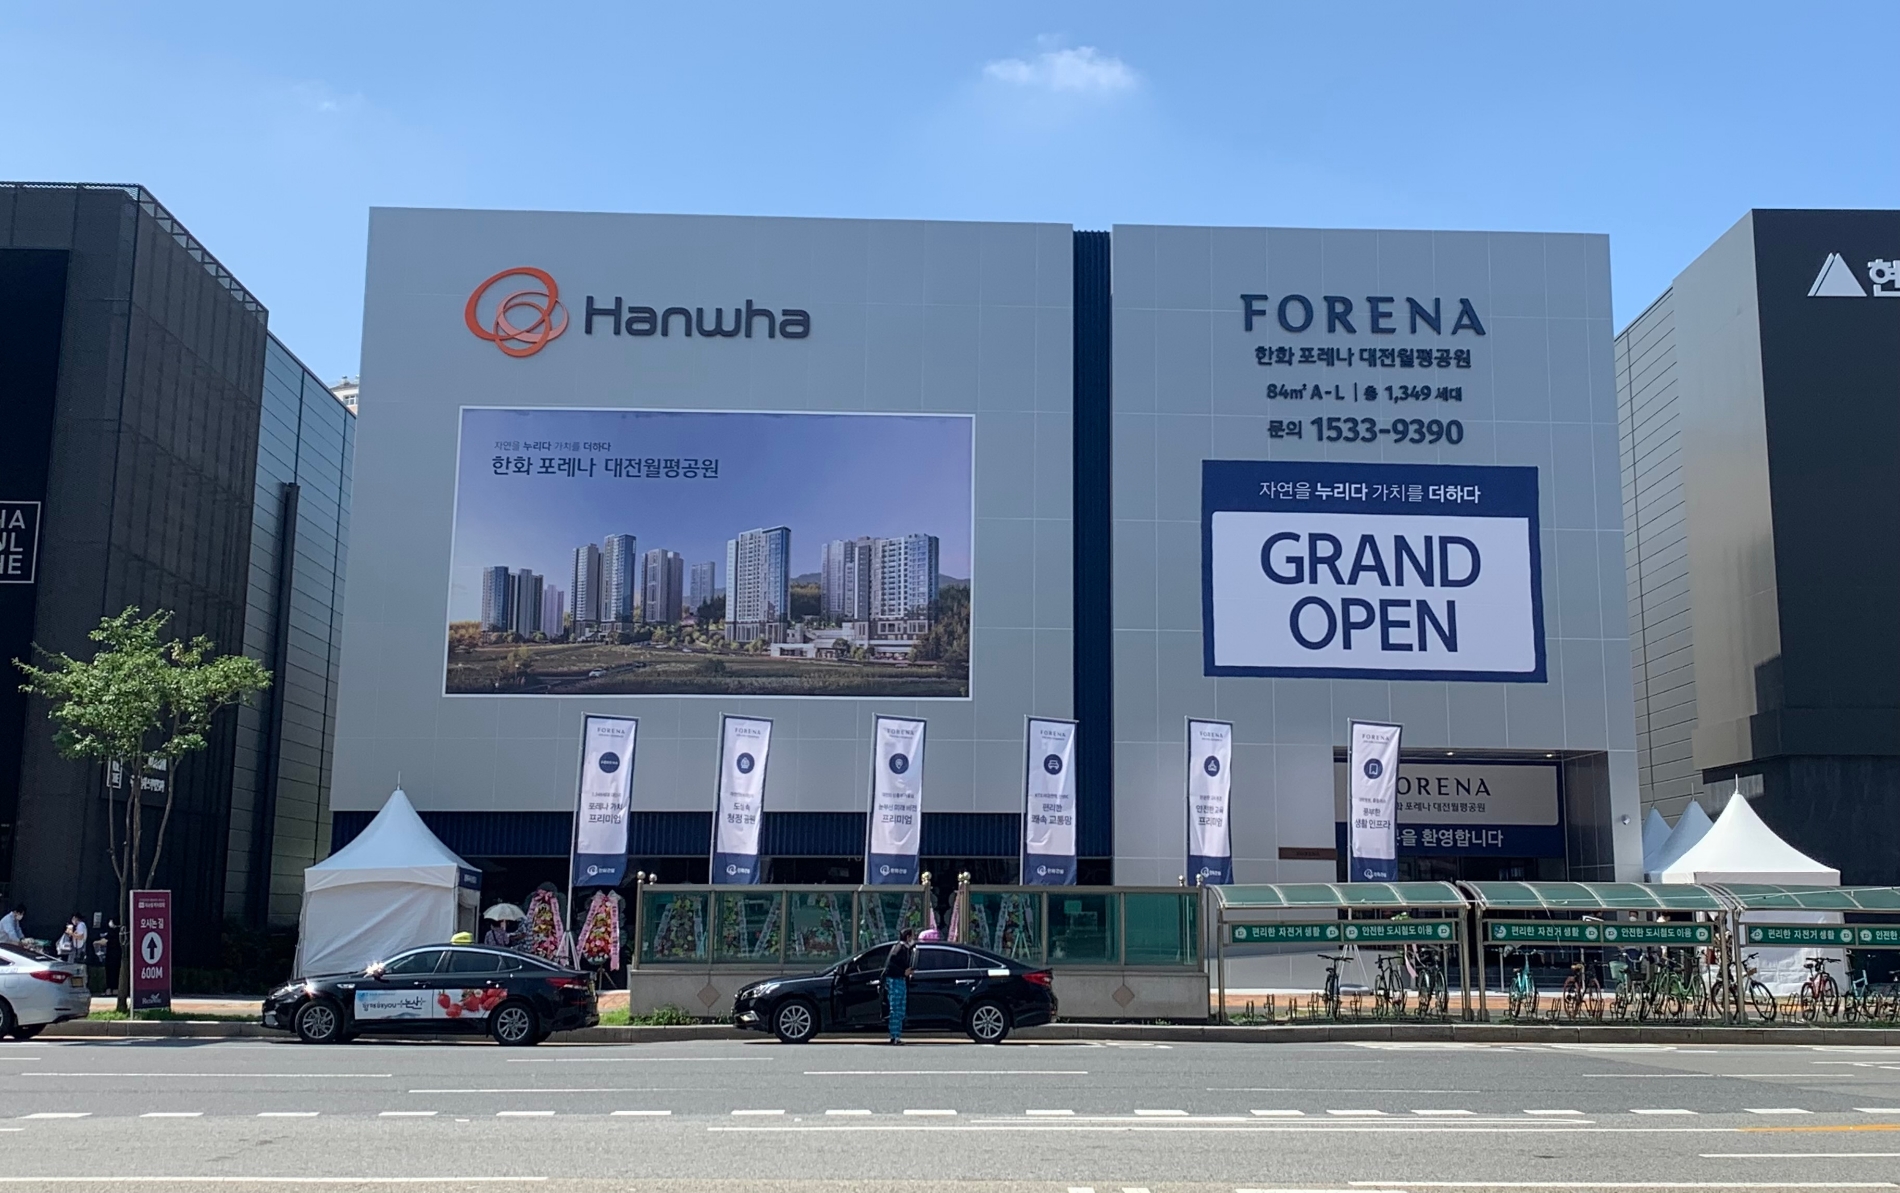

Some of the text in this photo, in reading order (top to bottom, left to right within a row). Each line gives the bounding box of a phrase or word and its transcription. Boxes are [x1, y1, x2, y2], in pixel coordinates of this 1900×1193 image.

[1868, 259, 1900, 297] 현
[584, 295, 811, 339] Hanwha
[1240, 294, 1486, 336] FORENA
[1255, 345, 1471, 369] 한화 포레나 대전월평공원
[1384, 385, 1431, 403] 1,349
[1435, 386, 1462, 402] 세대
[1268, 417, 1464, 444] 문의 1533-9390
[494, 441, 611, 452] 자연을 누리다 가치를 더하다
[492, 456, 719, 479] 한화 포레나 대전월평공원
[1259, 481, 1481, 504] 자연을 누리다 가치를 더하다
[1260, 531, 1481, 588] GRAND
[1289, 596, 1458, 652] OPEN
[597, 727, 625, 735] FORENA
[735, 727, 761, 735] FORENA
[1040, 729, 1066, 738] FORENA
[1362, 733, 1390, 742] FORENA
[1397, 776, 1492, 796] ORENA
[588, 803, 623, 811] 포레나 가치
[1042, 803, 1063, 813] 편리한
[1195, 805, 1214, 814] 안전한
[1363, 807, 1381, 817] 풍부한
[1405, 802, 1431, 811] 포레나
[1433, 802, 1486, 813] 대전월평공원
[588, 814, 622, 824] 프리미엄
[727, 813, 756, 825] 청정 공원
[881, 814, 912, 825] 프리미엄
[1031, 815, 1072, 826] 쾌속 교통망
[1198, 816, 1222, 828] 프리미엄
[1354, 818, 1391, 830] 생활 인프라
[1421, 828, 1503, 848] 환영합니다
[140, 918, 164, 929] 오시는 길
[1252, 925, 1320, 937] 편리한 자전거 생활
[1362, 924, 1433, 936] 안전한 도시철도 이용
[1511, 925, 1579, 938] 편리한 자전거 생활
[1621, 926, 1692, 939] 안전한 도시철도 이용
[1768, 927, 1835, 940] 편리한 자전거 생활
[1875, 928, 1898, 941] 안전한
[141, 966, 163, 979] 600M
